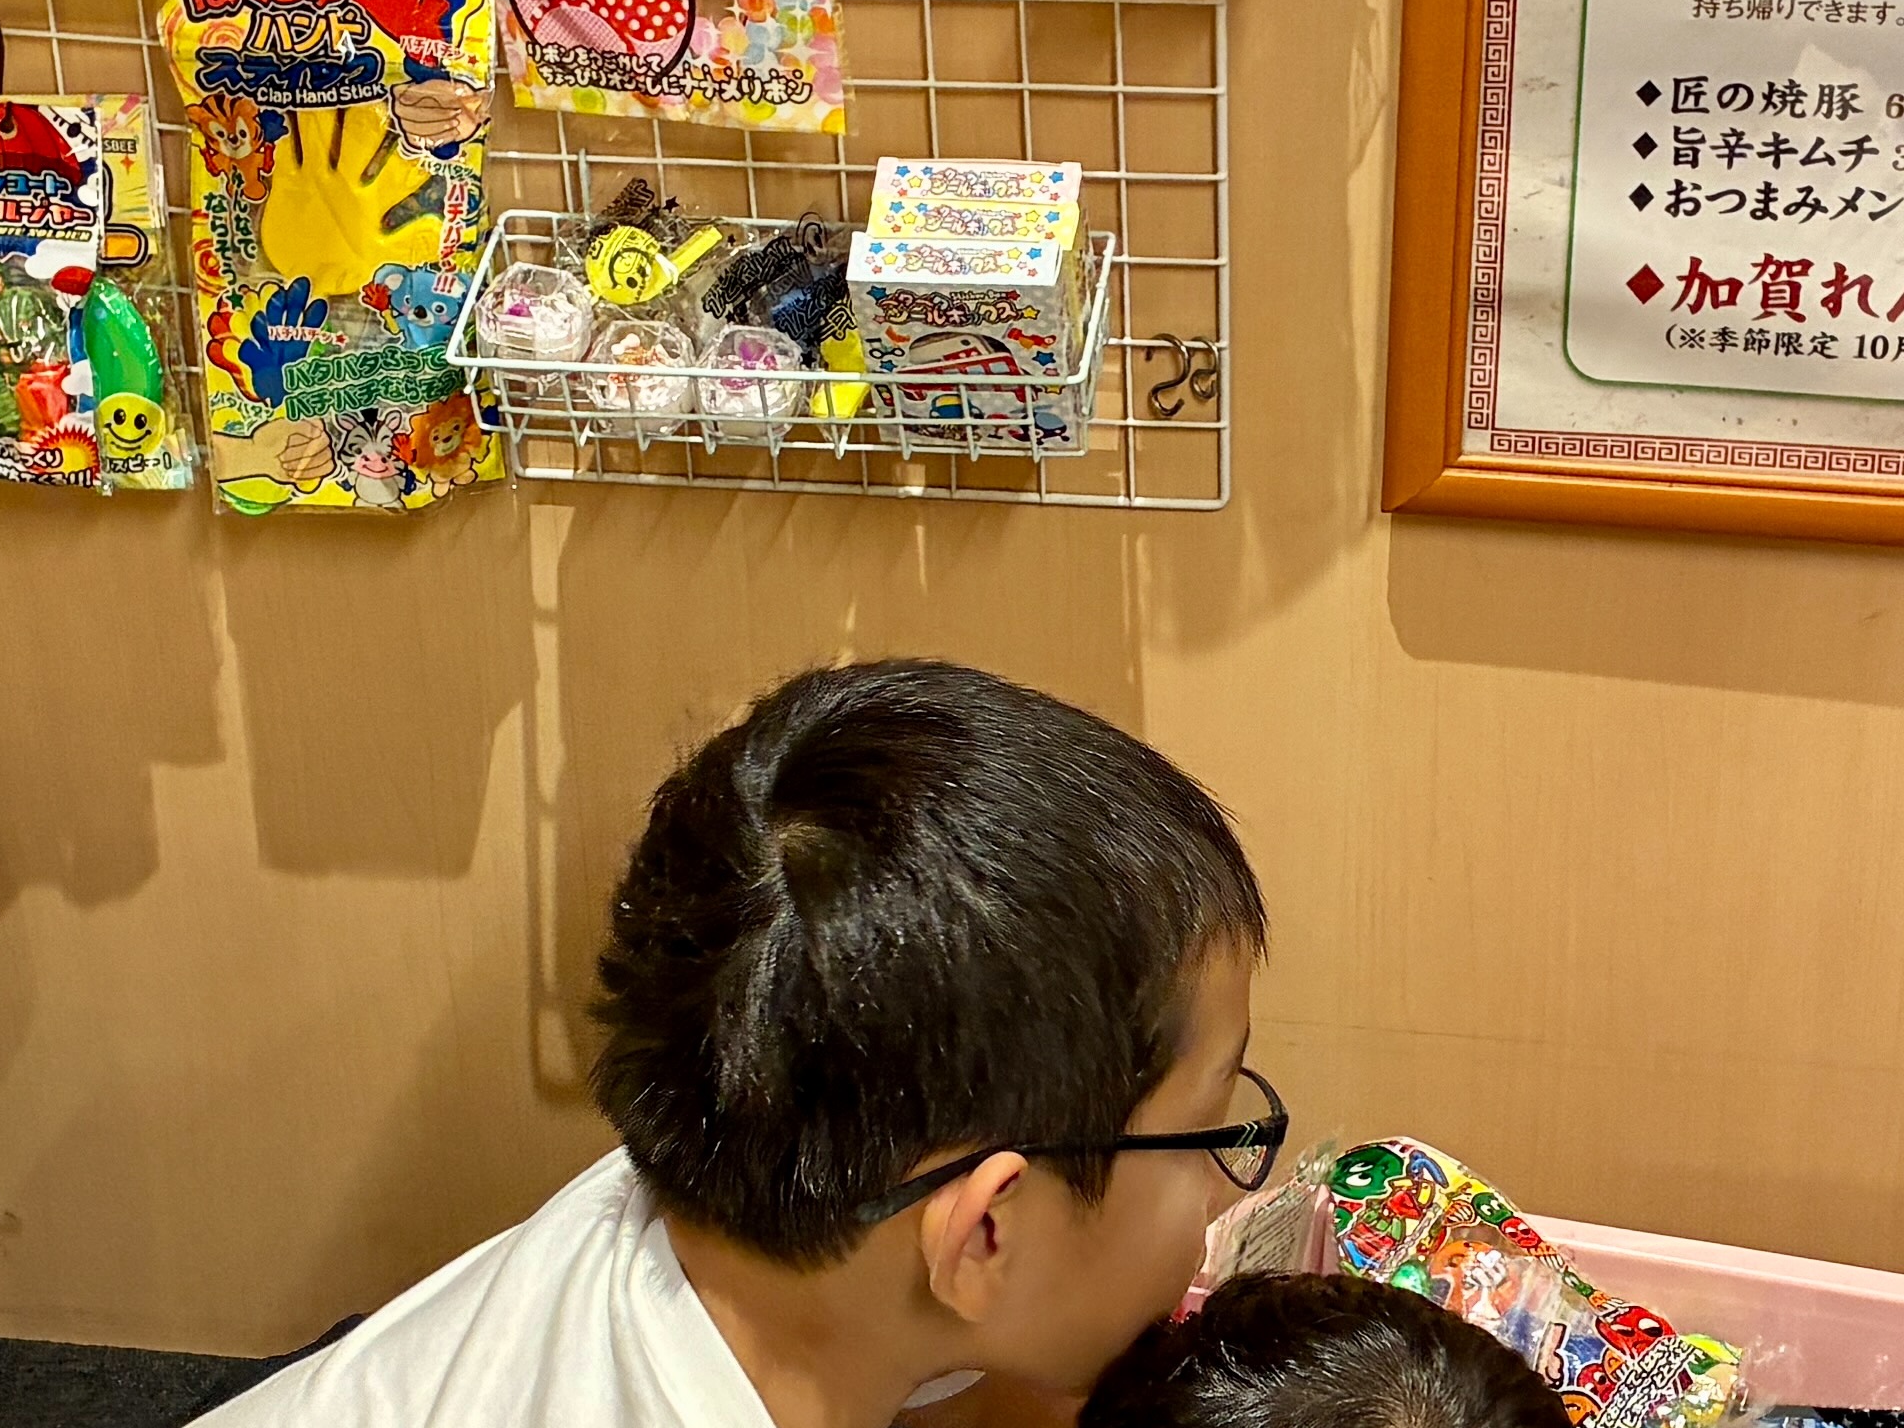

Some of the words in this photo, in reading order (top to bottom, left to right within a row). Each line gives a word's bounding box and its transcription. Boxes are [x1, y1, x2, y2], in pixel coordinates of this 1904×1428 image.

[252, 12, 365, 54] ハンド
[199, 51, 383, 91] スティック
[257, 85, 293, 103] Clap
[297, 86, 338, 104] Hand
[340, 84, 384, 101] Stick
[1670, 78, 1864, 117] 匠の焼豚
[1669, 126, 1880, 169] 旨辛キムチ
